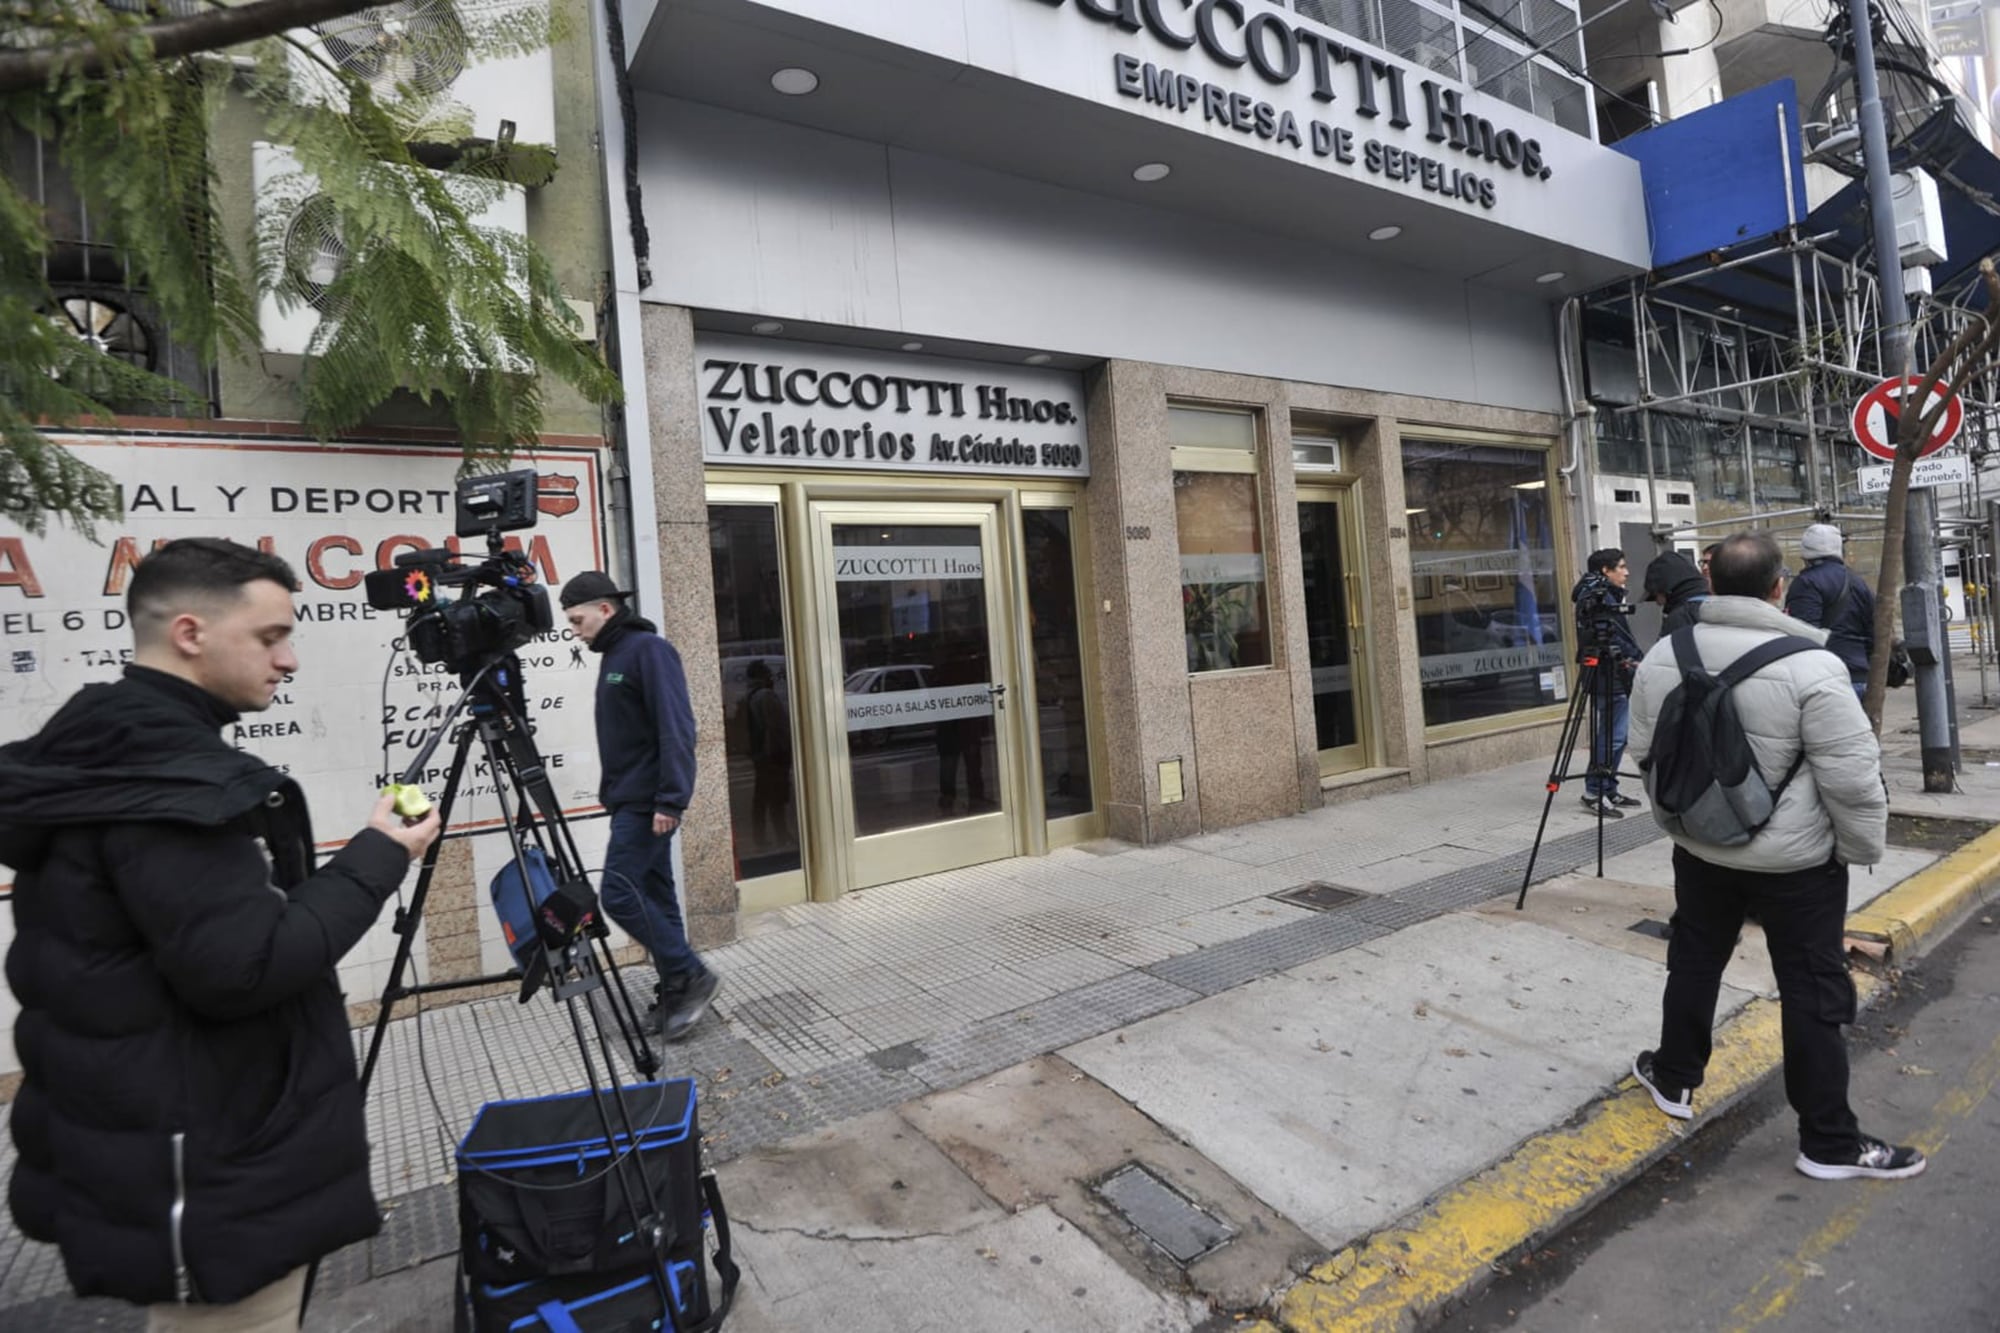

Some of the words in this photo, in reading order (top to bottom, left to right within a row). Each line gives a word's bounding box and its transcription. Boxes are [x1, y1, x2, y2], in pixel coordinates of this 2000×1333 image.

[1025, 0, 1411, 130] UCCOTTI
[1421, 79, 1552, 181] Hnos.
[1114, 53, 1302, 149] EMPRESA
[1311, 119, 1355, 165] DE
[1364, 138, 1496, 209] SEPELIOS
[703, 359, 966, 418] ZUCCOTTI
[976, 385, 1078, 424] Hnos.
[708, 406, 915, 461] Velatorios
[1040, 443, 1082, 467] 5080
[217, 486, 246, 513] Y
[270, 487, 456, 514] DEPORT
[837, 558, 936, 576] ZUCCOTTI
[63, 611, 84, 631] 6
[540, 697, 565, 709] DE
[847, 703, 894, 719] INGRESO
[895, 704, 903, 714] A
[904, 700, 938, 713] SALAS
